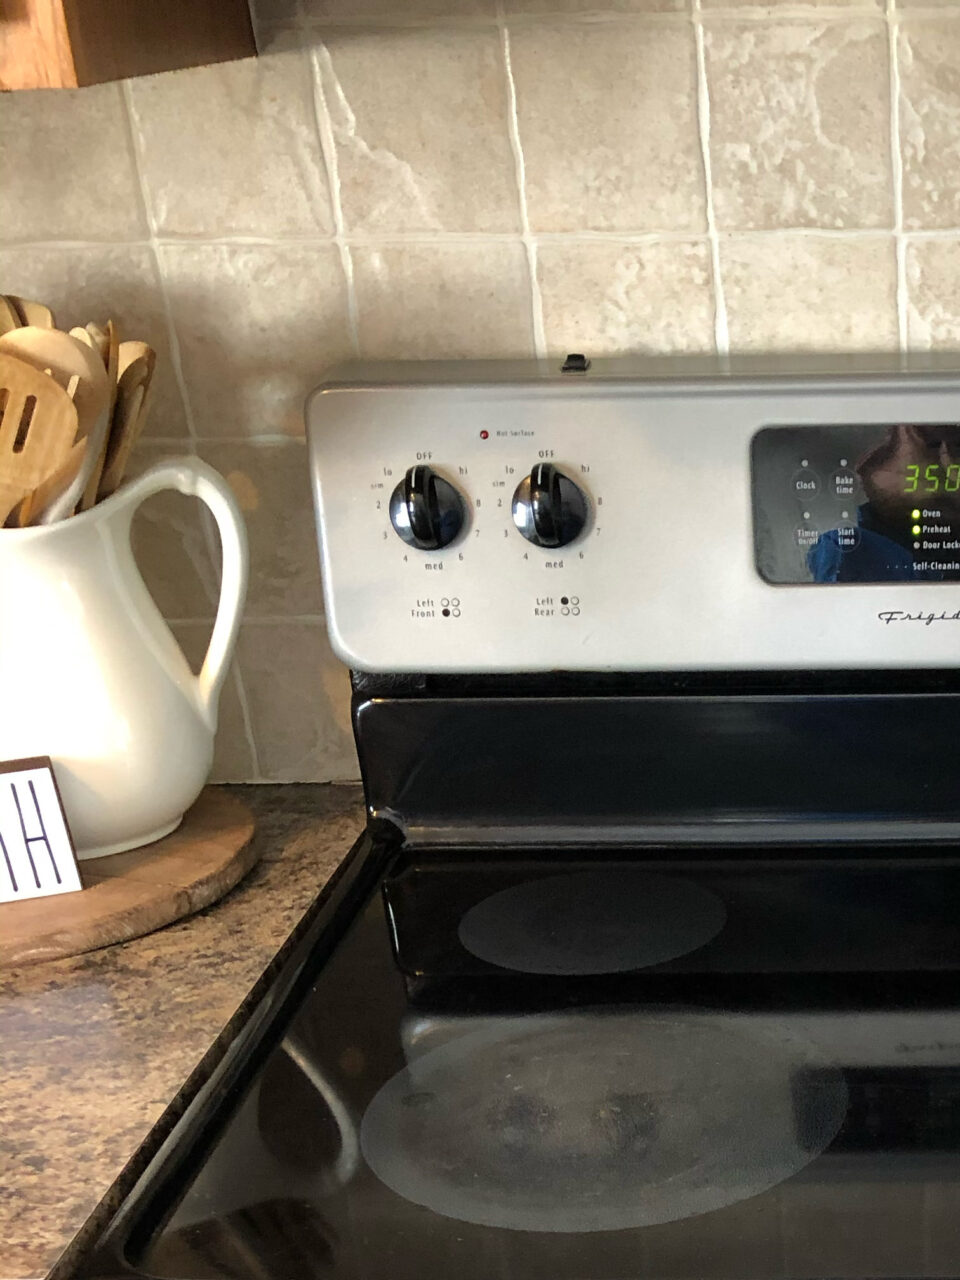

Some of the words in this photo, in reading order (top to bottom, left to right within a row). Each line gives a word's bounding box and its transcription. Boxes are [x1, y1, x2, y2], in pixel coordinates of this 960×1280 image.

[416, 452, 433, 460] OFF
[538, 450, 554, 458] OFF
[835, 476, 854, 485] Bake
[796, 481, 816, 490] Clock
[836, 486, 854, 494] time
[922, 509, 941, 518] Oven
[797, 529, 818, 537] Timer
[837, 528, 855, 536] Start
[922, 525, 951, 533] Preheat
[838, 537, 855, 545] time
[922, 541, 941, 549] Door
[425, 561, 443, 570] med
[545, 560, 564, 568] med
[416, 599, 434, 607] Left
[536, 597, 553, 606] Left
[411, 609, 435, 617] Front
[534, 607, 555, 616] Rear
